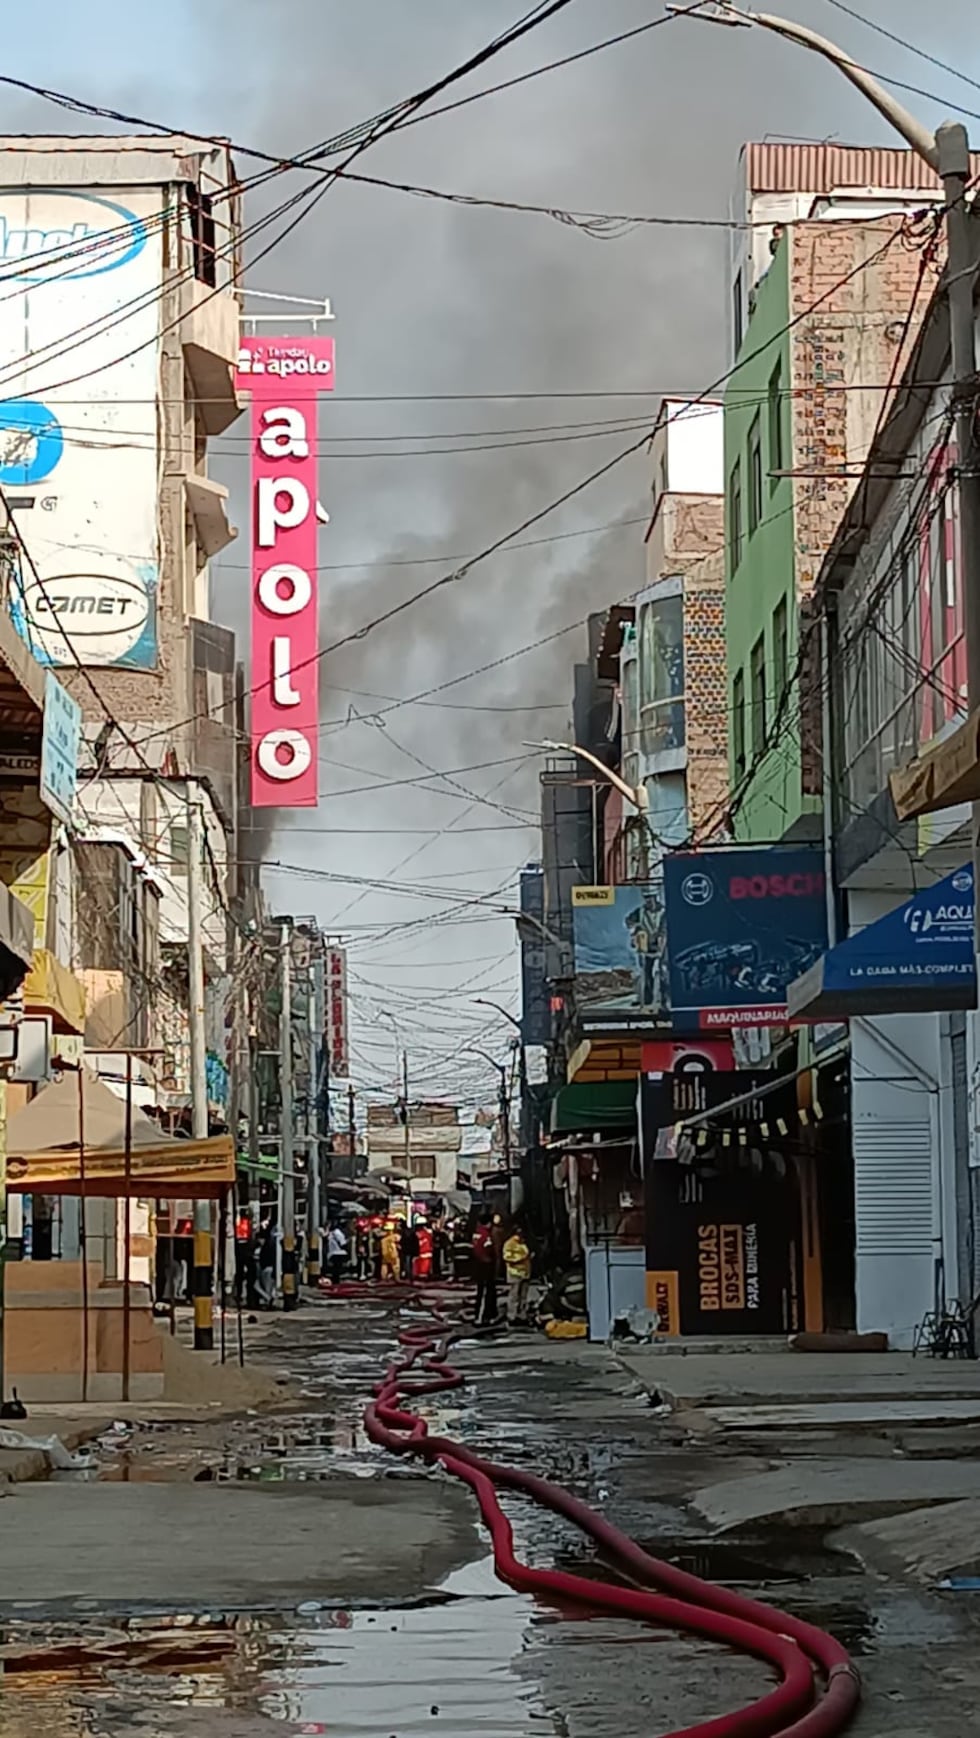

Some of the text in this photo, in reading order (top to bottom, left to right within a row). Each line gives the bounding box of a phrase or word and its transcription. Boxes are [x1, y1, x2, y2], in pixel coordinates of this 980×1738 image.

[267, 354, 331, 379] apolo
[256, 407, 313, 781] apolo
[729, 873, 825, 900] BOSCH
[850, 966, 863, 976] LA
[698, 1224, 720, 1310] BROCAS
[723, 1228, 740, 1305] SDS-MAX
[746, 1276, 760, 1309] PARA
